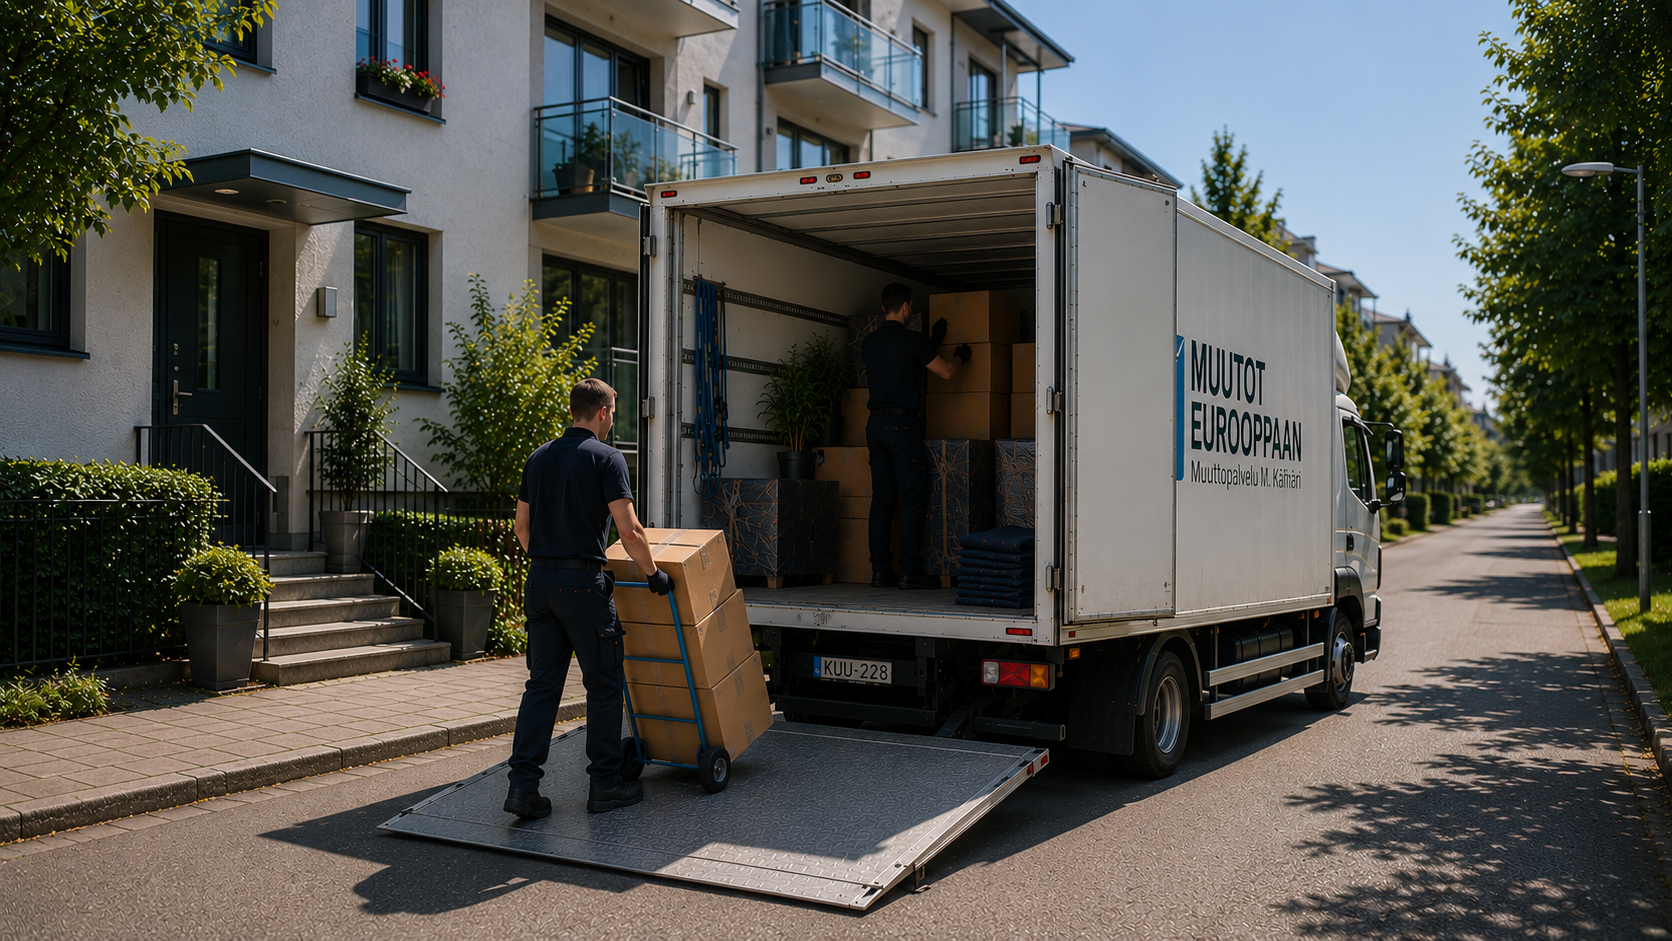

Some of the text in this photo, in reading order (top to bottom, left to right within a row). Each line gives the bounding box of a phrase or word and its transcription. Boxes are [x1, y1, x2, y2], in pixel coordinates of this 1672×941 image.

[1191, 339, 1266, 406] MUUTOT
[1191, 400, 1302, 462] EUROOPPAAN
[1191, 459, 1259, 491] Muuttopalvelu
[1260, 466, 1271, 488] M.
[824, 659, 888, 681] KUU-228
